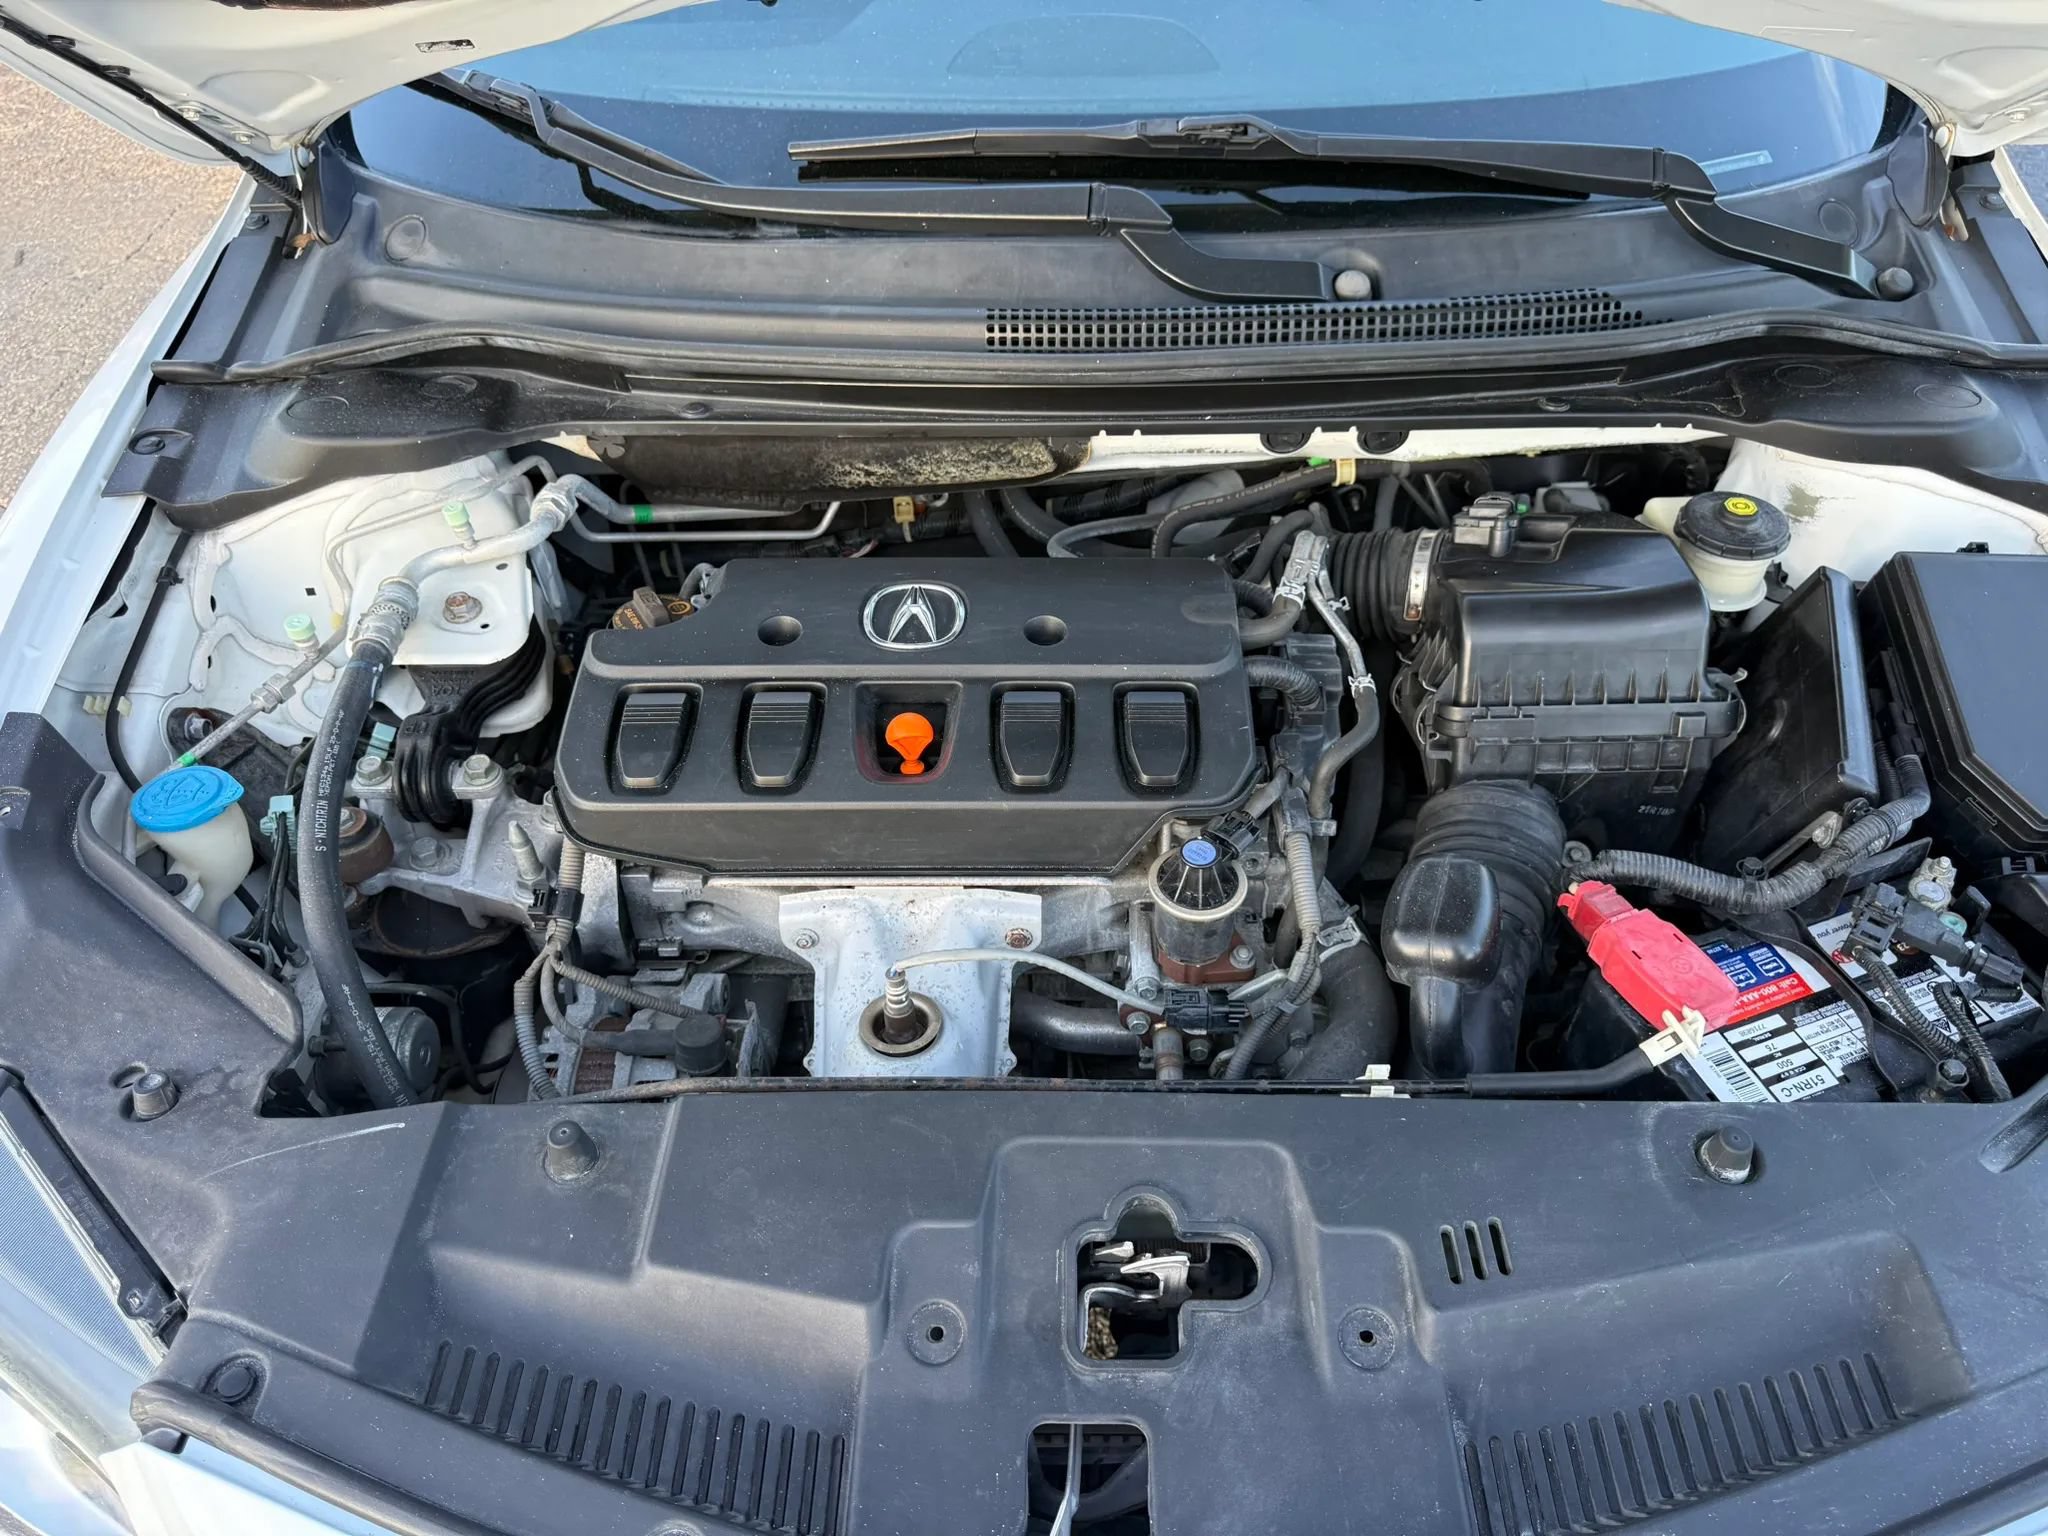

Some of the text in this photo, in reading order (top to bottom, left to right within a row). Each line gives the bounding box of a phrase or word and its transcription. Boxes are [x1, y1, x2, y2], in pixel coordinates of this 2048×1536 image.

[1815, 929, 1831, 938] you
[1764, 1042, 1778, 1051] 75
[1777, 1059, 1794, 1069] 500
[1781, 1075, 1825, 1097] 51RN-C
